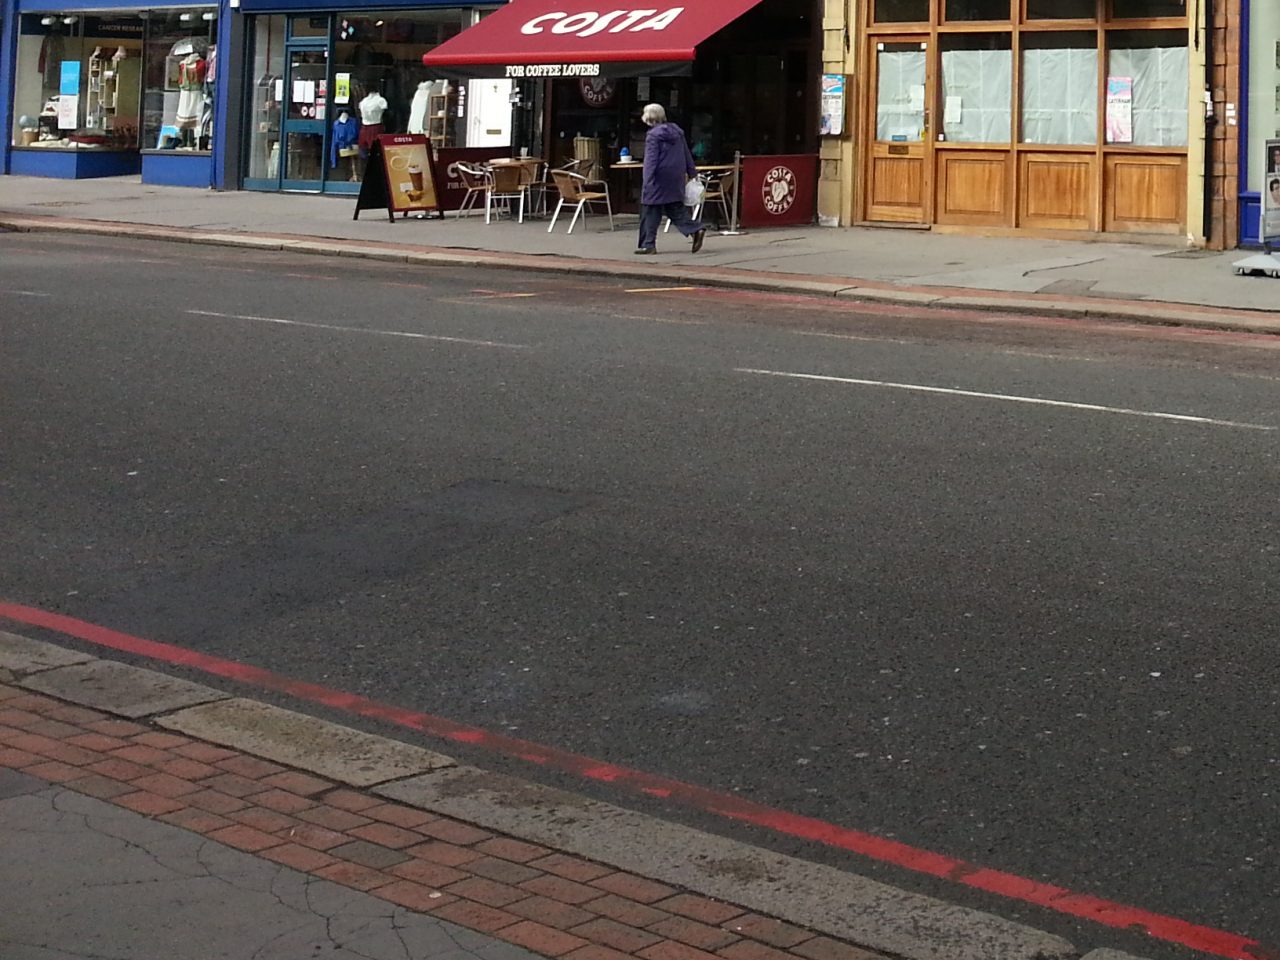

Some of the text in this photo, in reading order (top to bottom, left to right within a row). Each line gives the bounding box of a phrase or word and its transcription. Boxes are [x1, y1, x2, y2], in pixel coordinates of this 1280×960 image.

[520, 7, 685, 37] COSTA
[505, 63, 600, 78] FOR COFFEE LOVERS
[767, 169, 792, 183] COSTA
[765, 195, 793, 212] COFFEE
